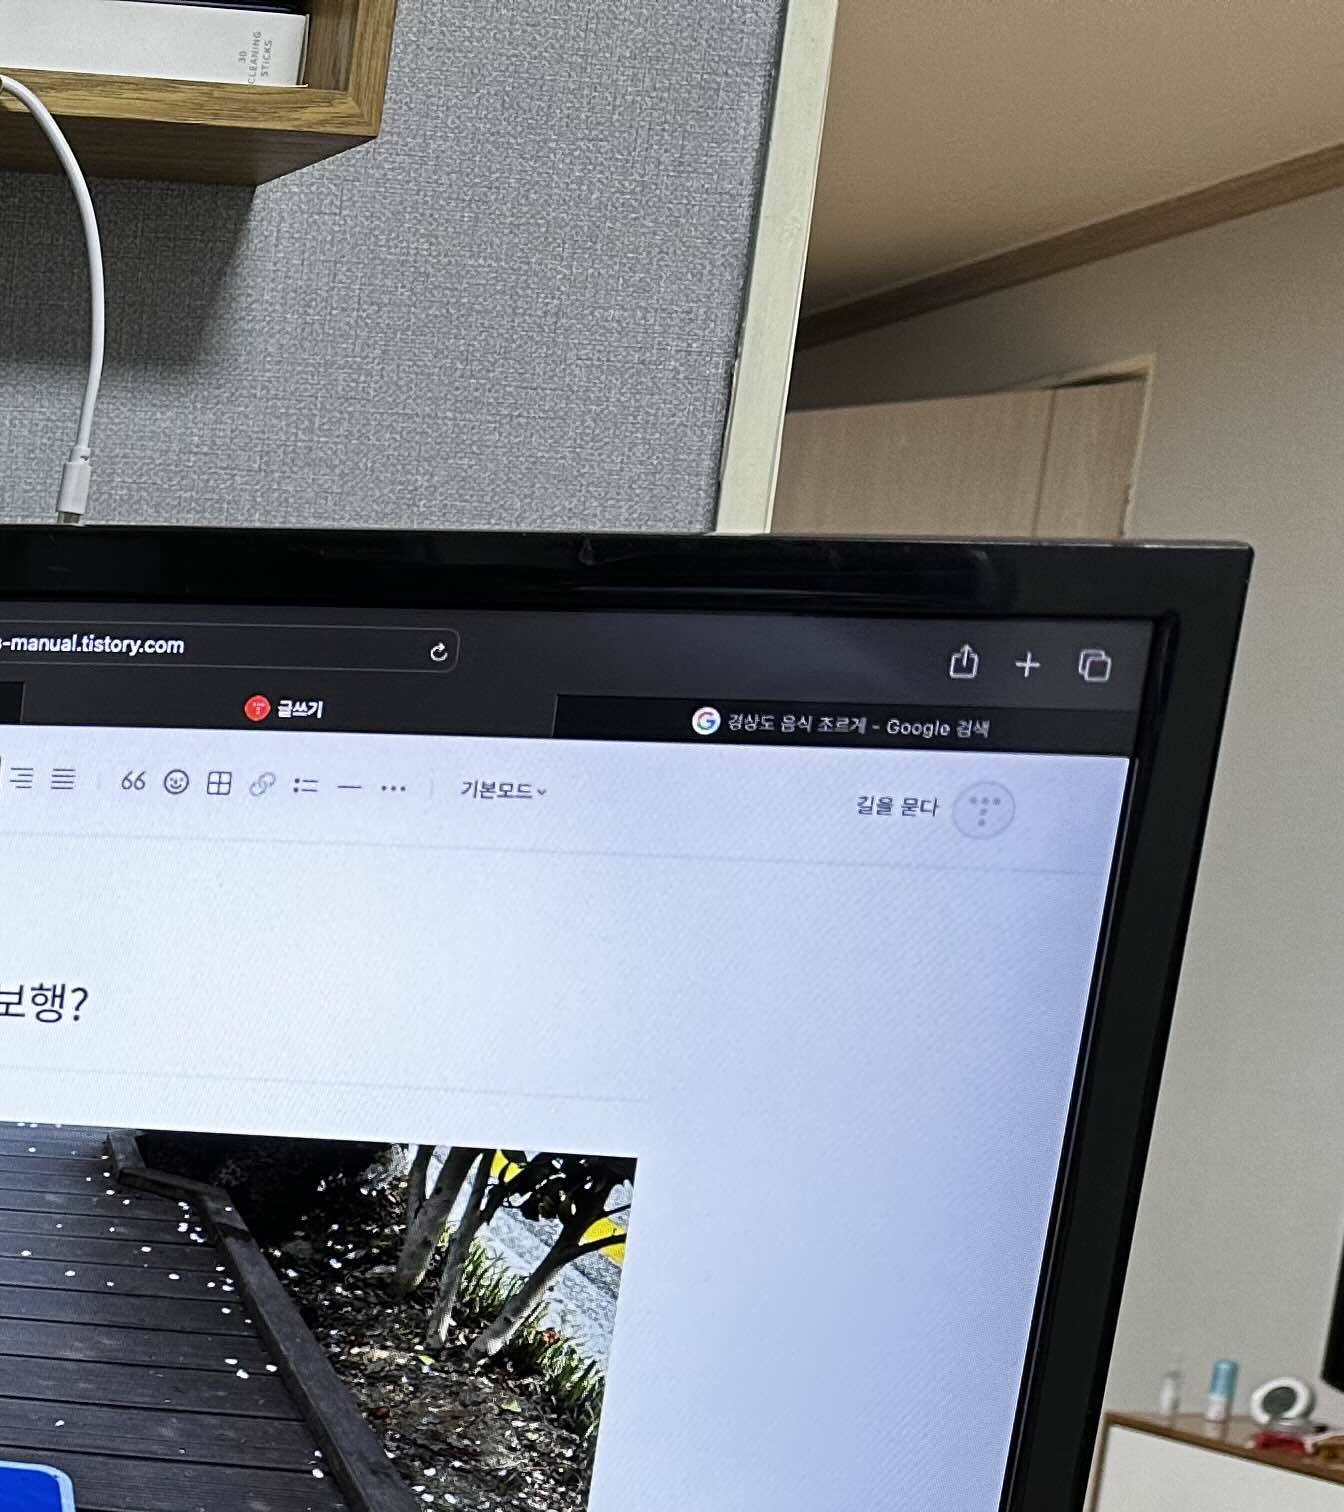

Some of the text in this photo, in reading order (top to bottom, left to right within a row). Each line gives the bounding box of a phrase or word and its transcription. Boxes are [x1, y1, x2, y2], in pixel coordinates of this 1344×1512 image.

[238, 50, 248, 63] 30
[248, 31, 262, 84] CLEANING
[260, 39, 273, 77] STICKS
[277, 700, 324, 718] 글쓰기
[728, 713, 775, 732] 경상도
[780, 715, 813, 733] 음식
[886, 719, 951, 739] Google
[956, 720, 990, 738] 검색
[461, 780, 533, 800] 기본모드
[857, 795, 940, 817] 길을 묻다
